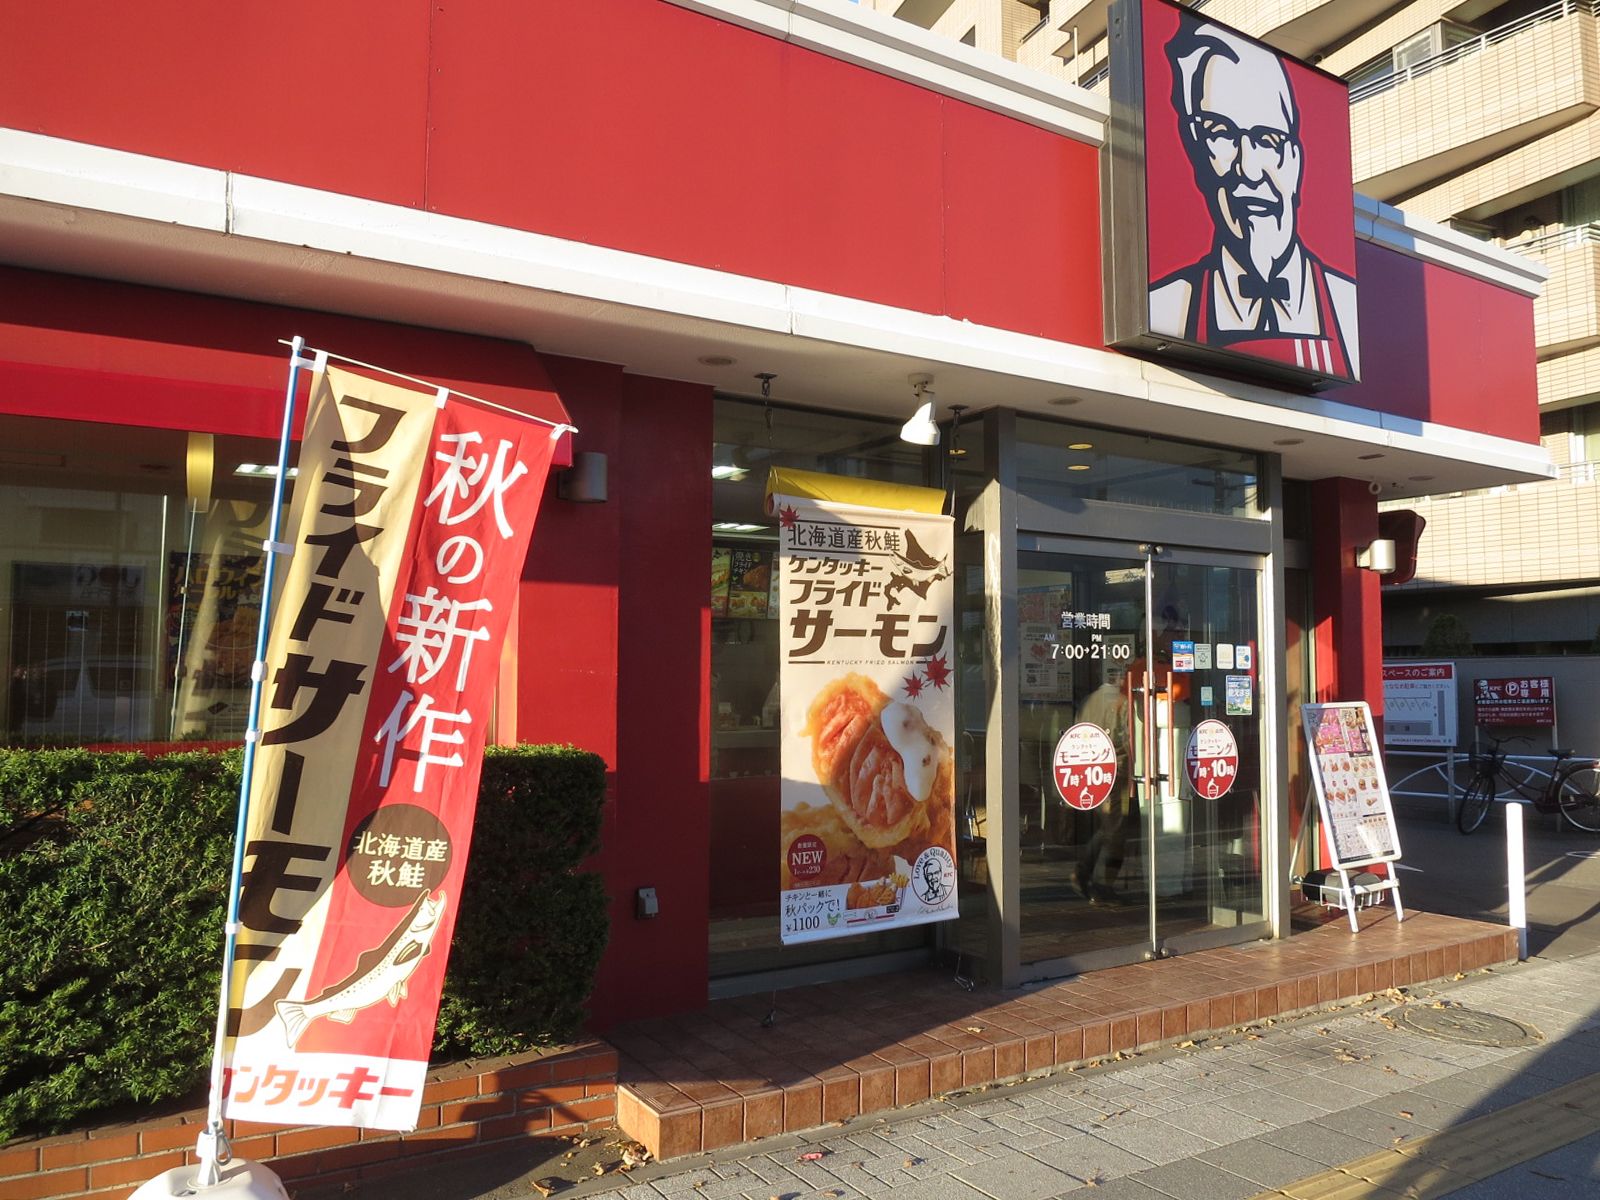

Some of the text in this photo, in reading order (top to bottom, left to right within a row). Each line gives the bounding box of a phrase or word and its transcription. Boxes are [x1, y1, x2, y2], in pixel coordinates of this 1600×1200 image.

[788, 524, 900, 551] 北海道産秋鮭
[788, 554, 883, 577] ケンタッキー
[789, 579, 882, 607] フライド
[373, 431, 528, 793] 秋の新作
[1061, 611, 1111, 630] 営業時間
[788, 609, 947, 658] サーモン
[1044, 633, 1103, 642] AM PM
[1051, 643, 1130, 660] 7:00 21:00
[227, 394, 407, 1038] フライドサーモン
[1059, 747, 1111, 764] モーニング
[1190, 742, 1233, 757] モーニング
[1059, 765, 1112, 788] 7時 10時
[1190, 759, 1235, 779] 7時 10時
[353, 830, 448, 863] 北海道産
[792, 850, 824, 865] NEW
[367, 859, 426, 888] 秋鮭
[785, 889, 832, 902] チキンと一緒に
[785, 915, 820, 932] ¥1100
